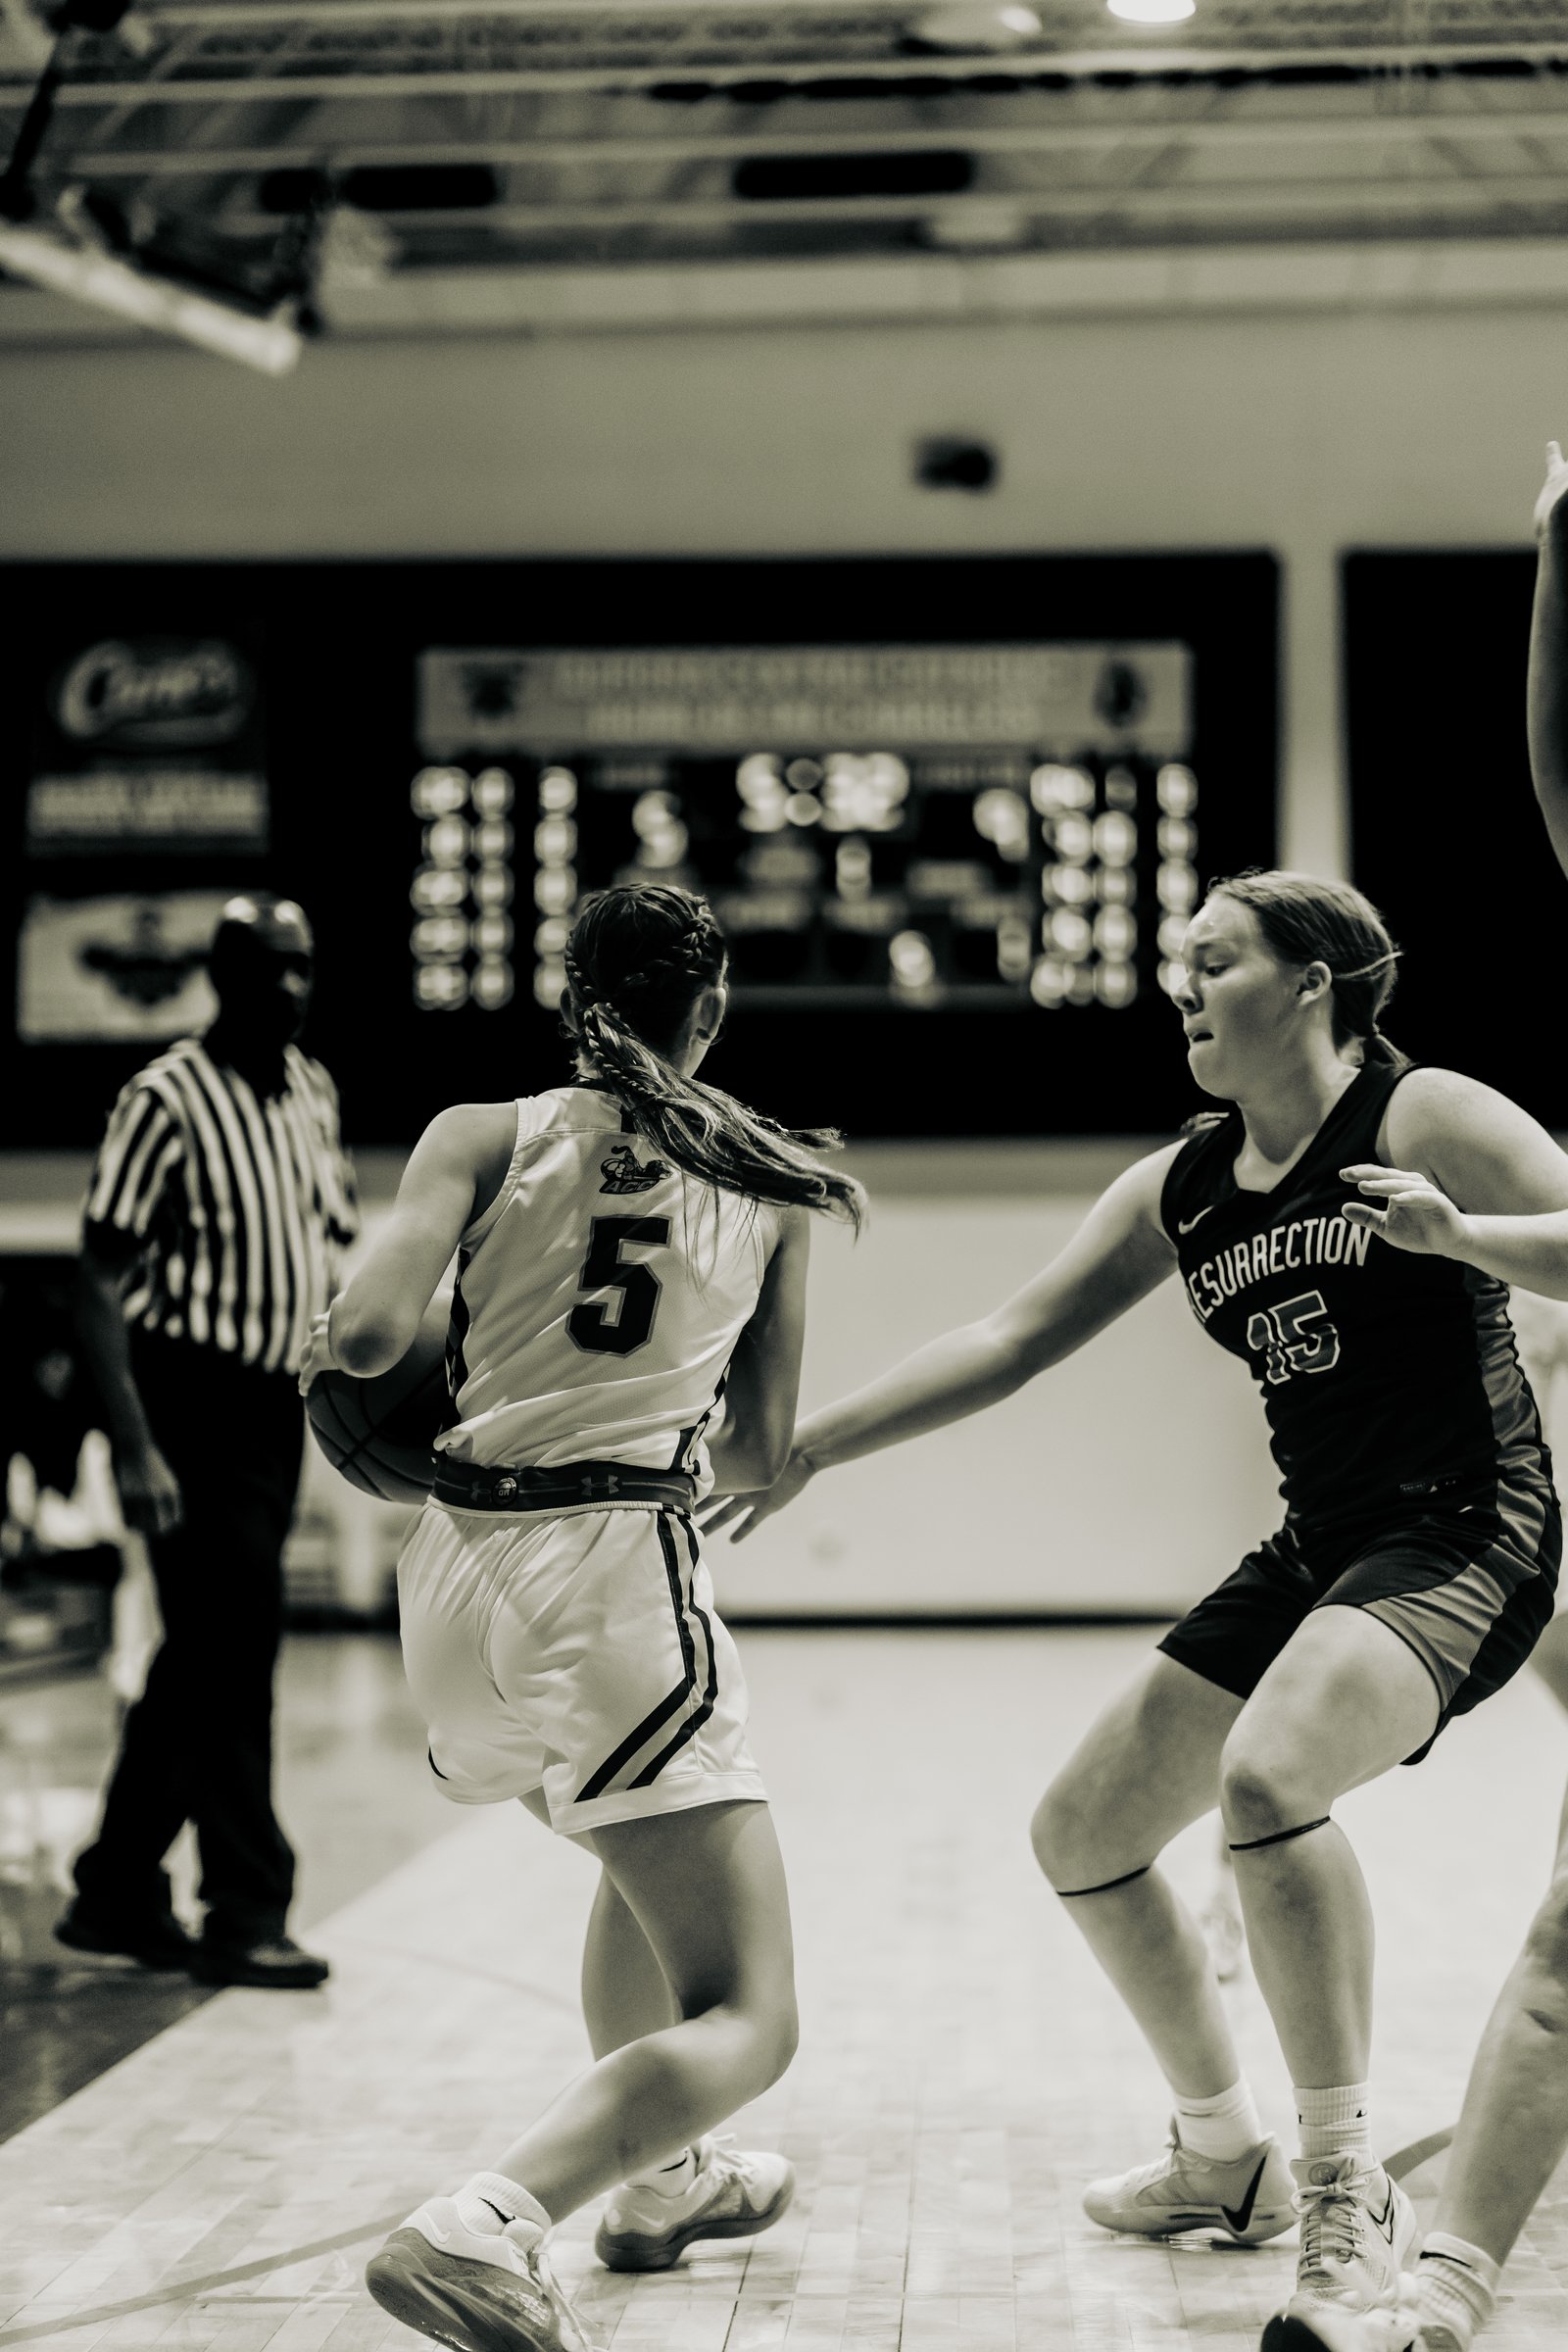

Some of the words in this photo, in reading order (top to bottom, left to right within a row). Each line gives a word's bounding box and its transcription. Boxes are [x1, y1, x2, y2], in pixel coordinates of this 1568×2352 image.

[603, 1179, 657, 1194] ACC
[564, 1214, 673, 1358] 5
[1186, 1216, 1372, 1323] ESURRECTION
[1247, 1290, 1341, 1385] 15
